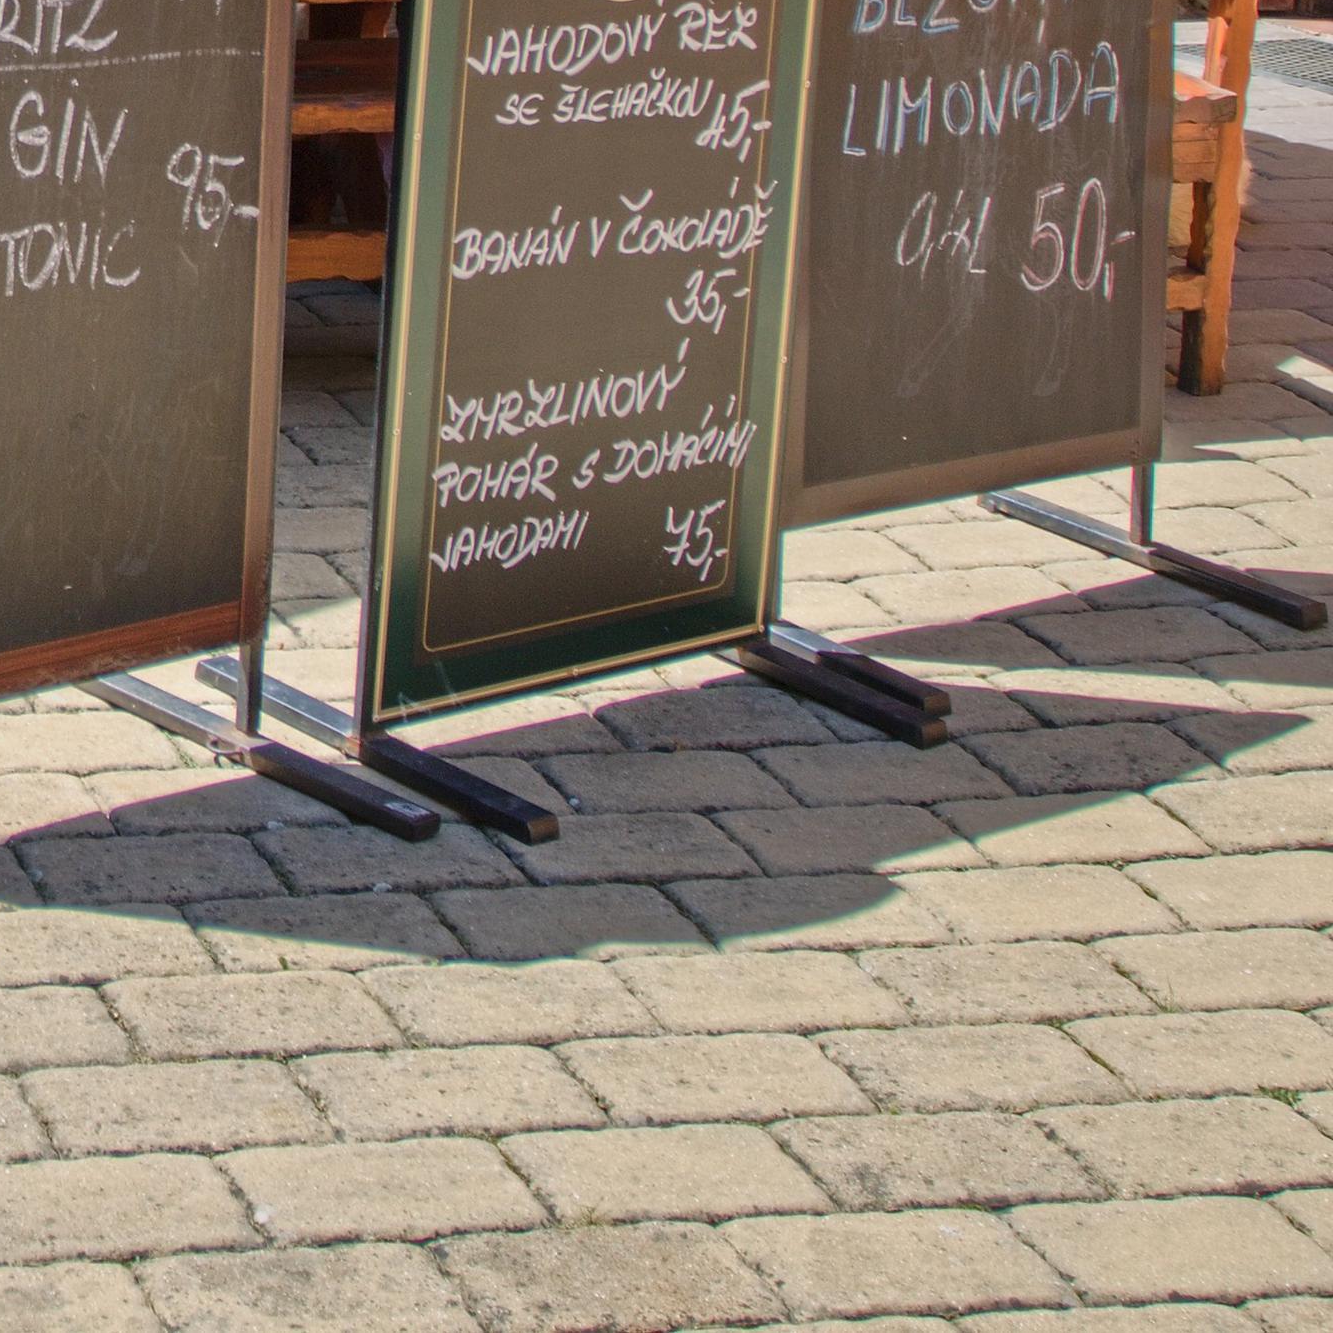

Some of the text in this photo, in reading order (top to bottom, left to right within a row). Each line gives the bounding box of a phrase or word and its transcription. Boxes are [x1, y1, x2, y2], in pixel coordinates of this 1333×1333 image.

[496, 92, 544, 126] SE
[553, 67, 714, 125] ŠLEHAČKOU
[10, 91, 129, 187] GIN
[451, 205, 580, 280] BANÁN
[590, 217, 611, 257] V
[666, 269, 751, 335] 35,-
[439, 336, 691, 444] ZMRZLINOVÝ
[432, 442, 559, 508] POHÁR
[572, 449, 600, 490] S
[428, 509, 590, 573] JAHODAMI
